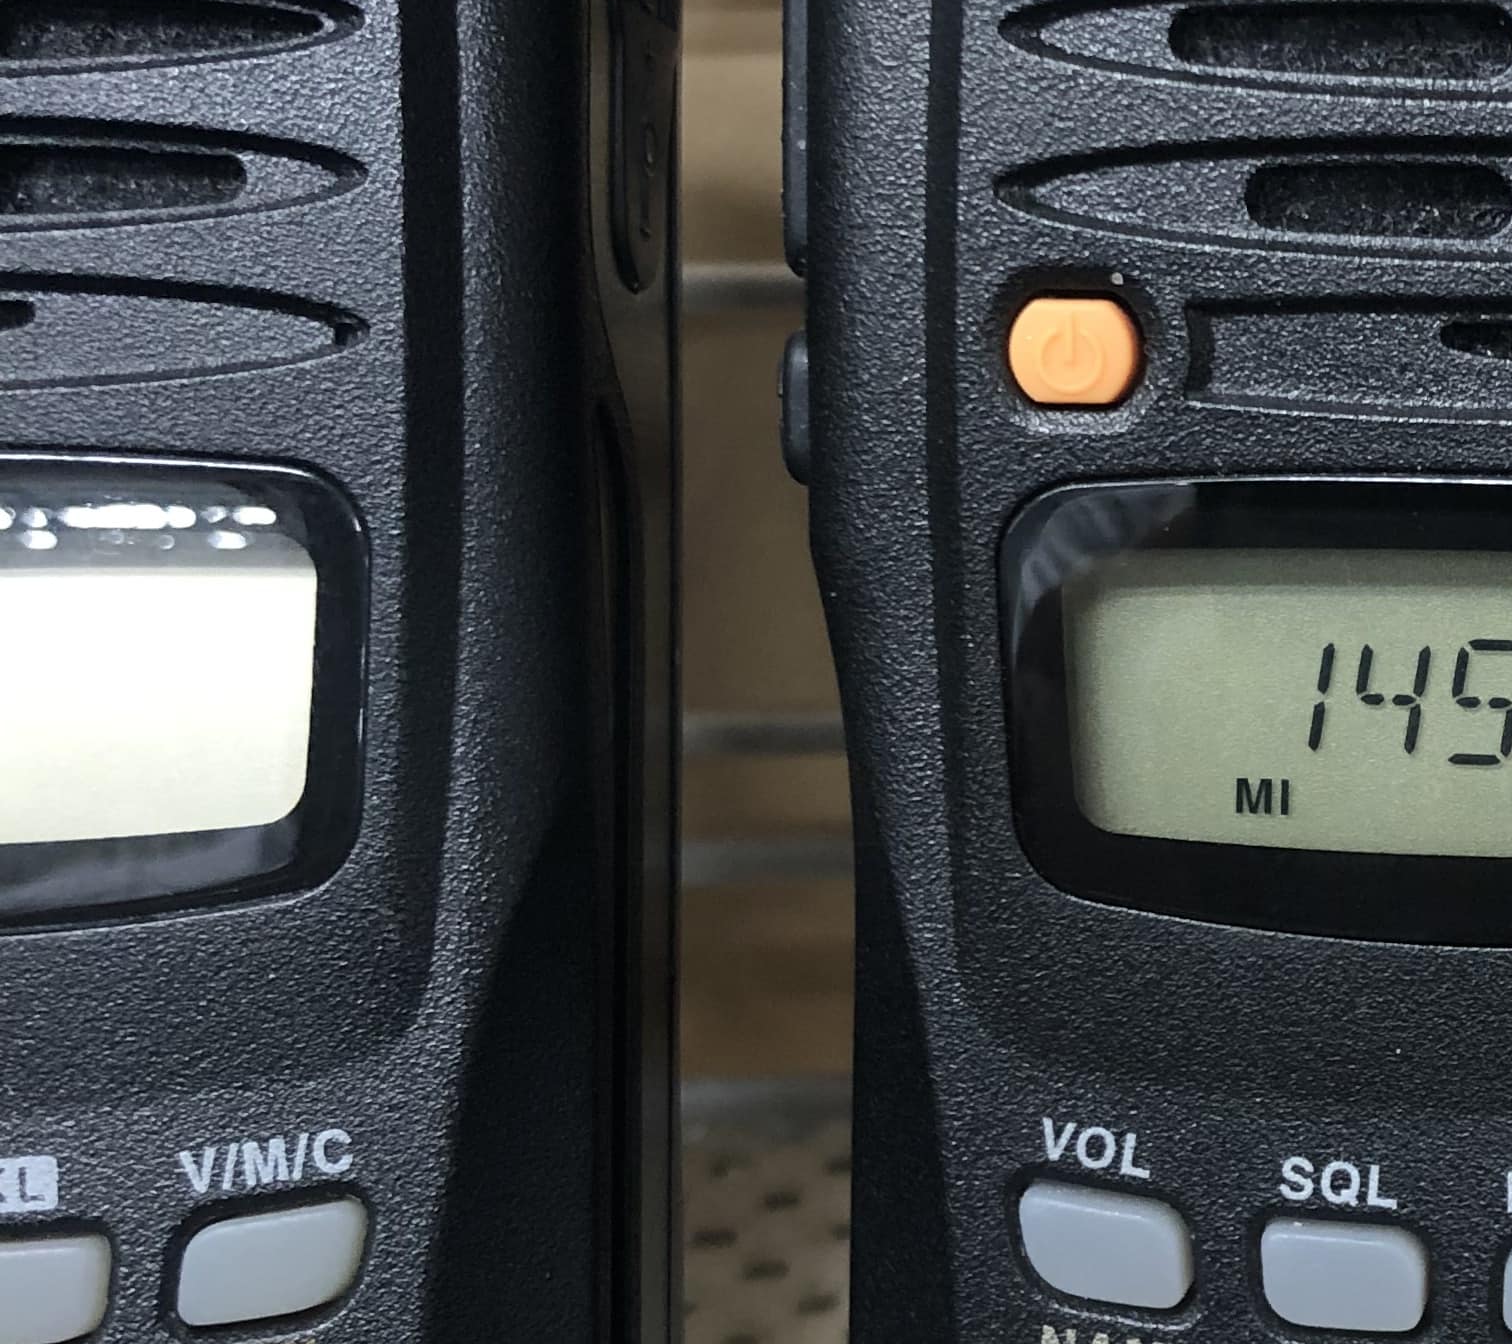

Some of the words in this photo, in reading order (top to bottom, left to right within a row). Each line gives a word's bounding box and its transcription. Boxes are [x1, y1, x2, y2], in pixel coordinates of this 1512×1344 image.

[177, 1128, 354, 1195] V/M/C
[1042, 1117, 1151, 1180] VOL
[1278, 1158, 1399, 1211] SQL
